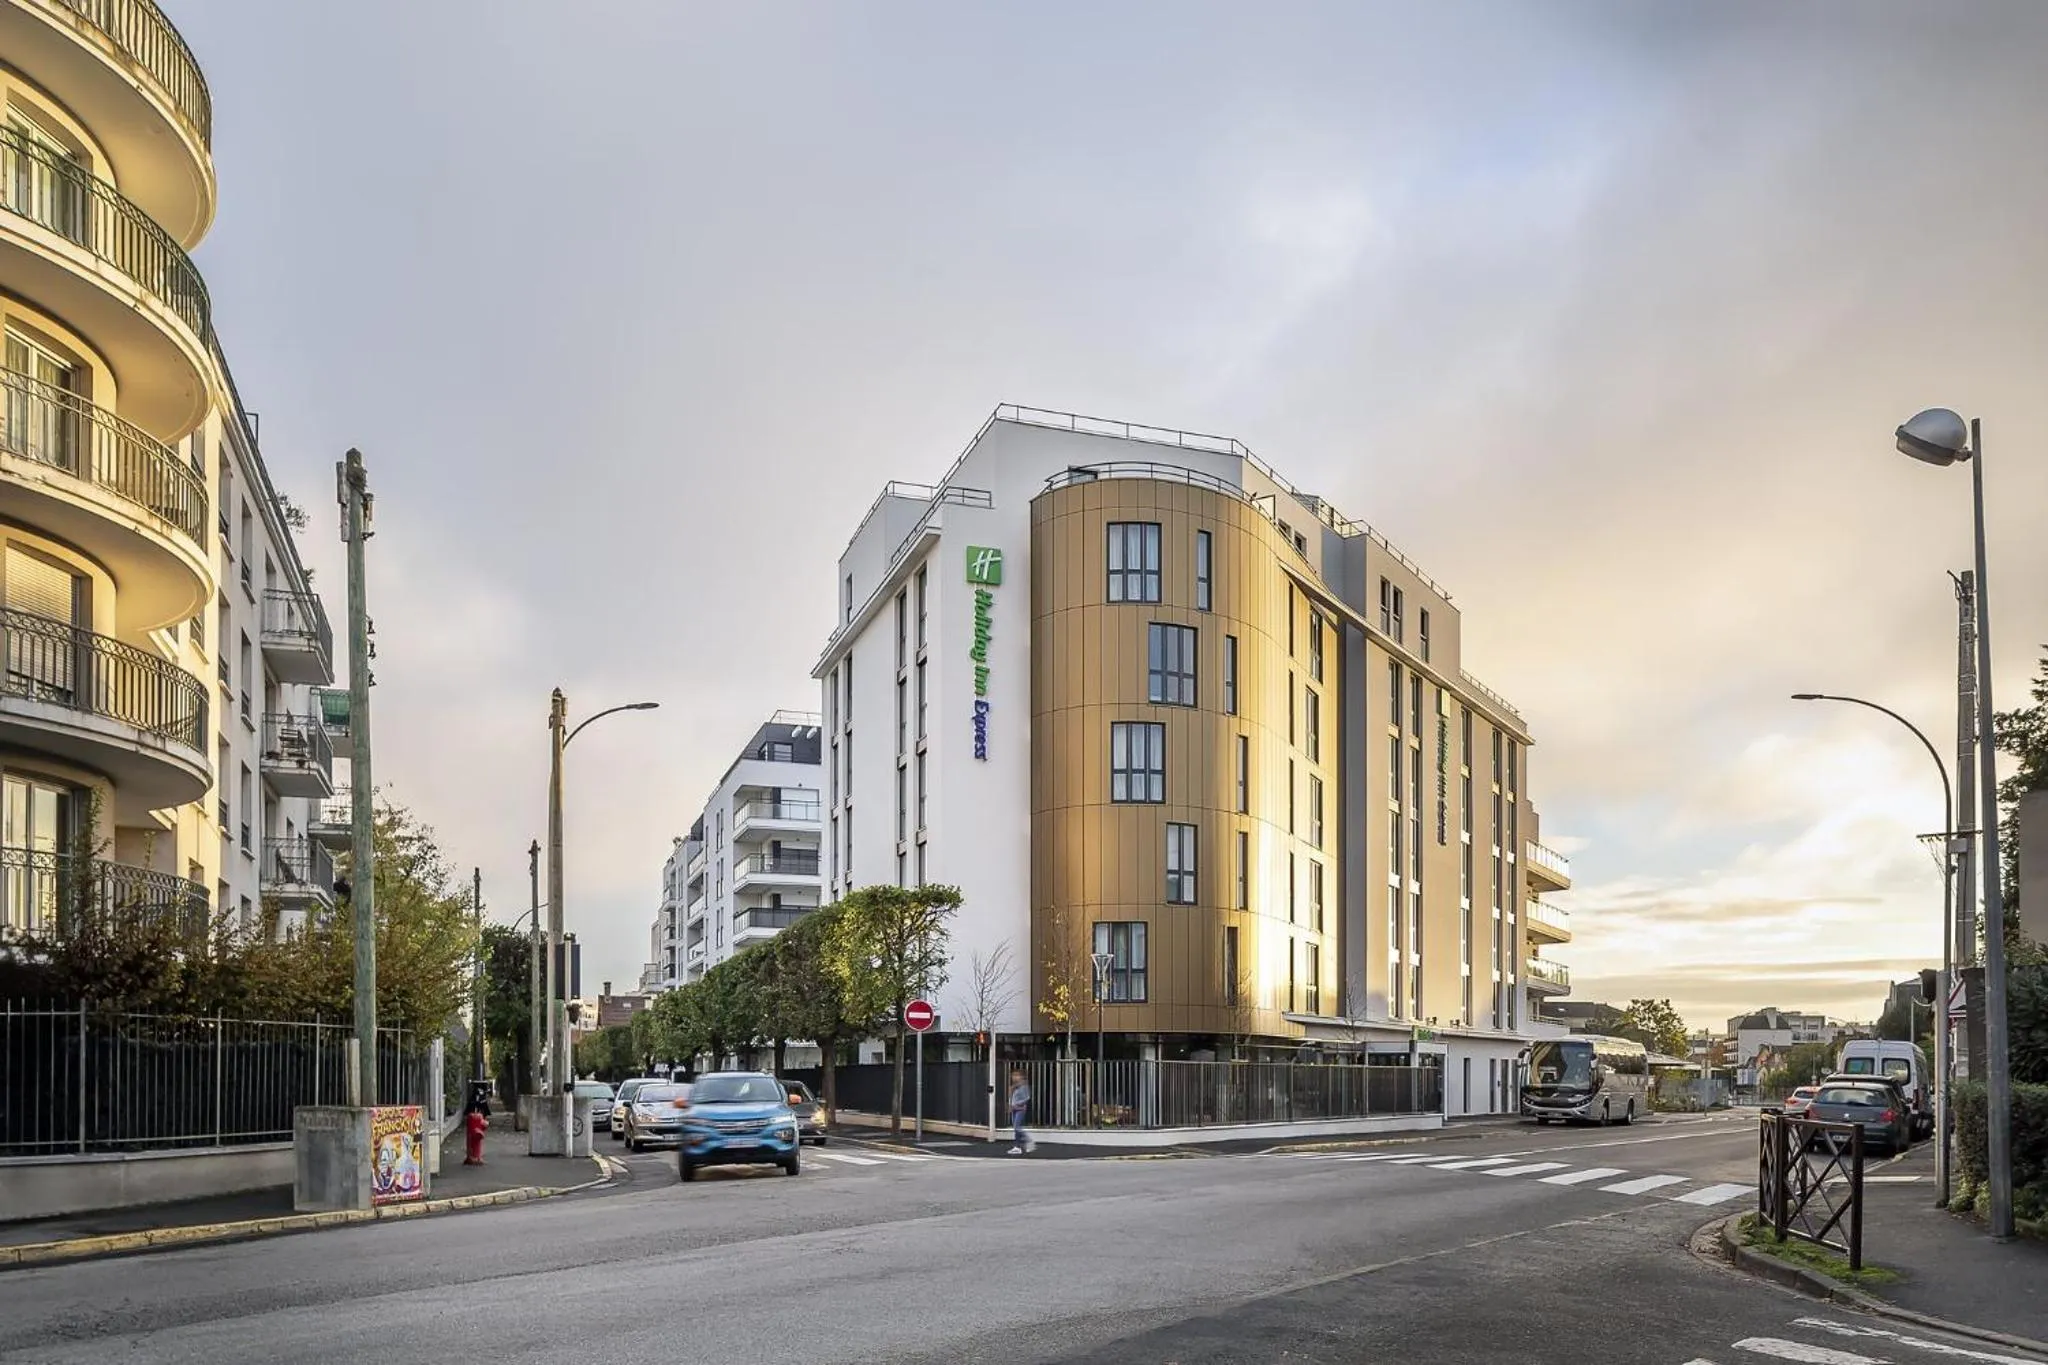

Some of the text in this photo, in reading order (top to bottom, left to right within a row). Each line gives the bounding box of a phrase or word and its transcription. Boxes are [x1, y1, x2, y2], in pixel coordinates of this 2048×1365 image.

[970, 589, 993, 761] Holiday Inn Express
